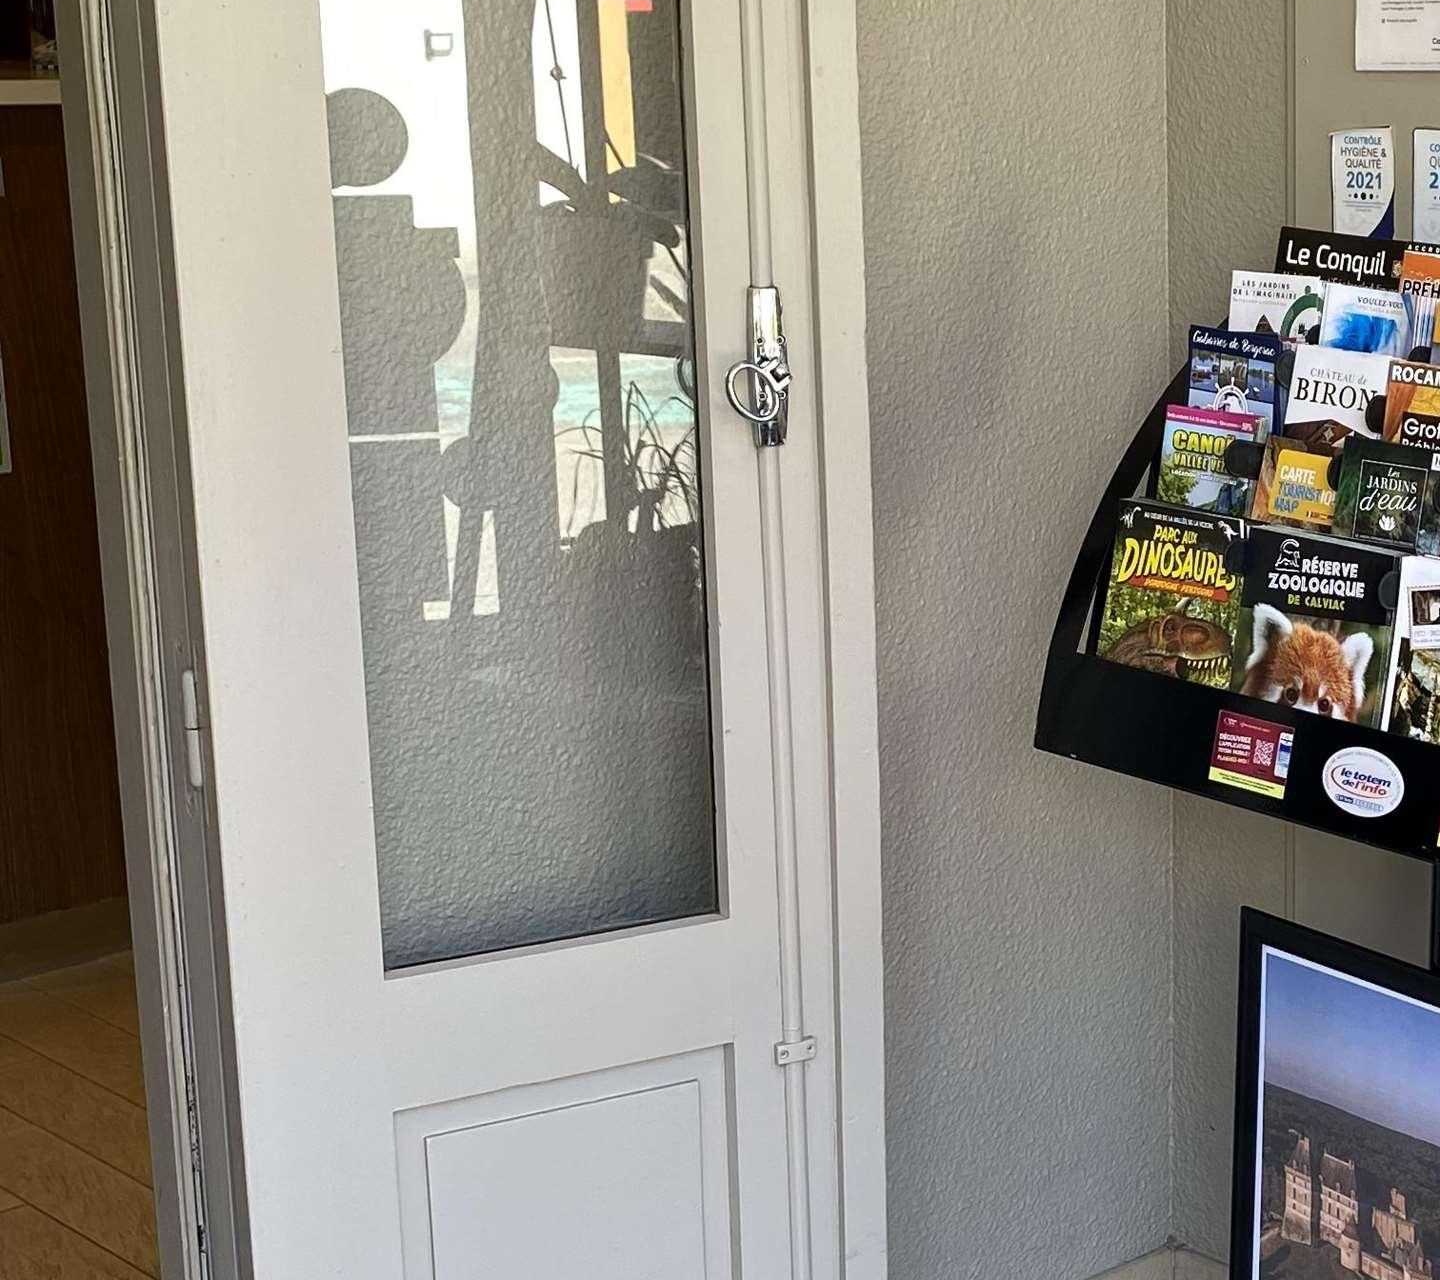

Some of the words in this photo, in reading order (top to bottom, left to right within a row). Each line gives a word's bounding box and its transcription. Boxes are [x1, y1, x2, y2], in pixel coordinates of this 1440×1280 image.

[1344, 136, 1382, 145] CONTRÔLE
[1381, 148, 1387, 157] &
[1345, 157, 1382, 169] QUALITÉ
[1346, 171, 1382, 189] 2021
[1286, 240, 1310, 266] Le
[1316, 244, 1386, 281] Conquil
[1233, 288, 1243, 296] DE
[1245, 288, 1297, 300] L'IMAGINAIRE
[1242, 279, 1256, 288] LES
[1259, 280, 1290, 290] JARDINS
[1228, 337, 1240, 350] de
[1241, 338, 1277, 358] Bergerac
[1357, 375, 1369, 386] de
[1294, 377, 1379, 412] BIRON
[1172, 428, 1235, 458] CANO
[1280, 464, 1317, 485] CARTE
[1387, 466, 1401, 478] Les
[1366, 475, 1418, 495] JARDINS
[1359, 489, 1418, 512] d'eau
[1153, 524, 1181, 543] PARC
[1182, 530, 1199, 545] AUX
[1301, 555, 1359, 579] RÉSERVE
[1267, 572, 1366, 599] ZOOLOGIQUE
[1287, 593, 1300, 606] DE
[1304, 596, 1345, 611] CALVIAC
[1340, 767, 1352, 778] le
[1353, 771, 1391, 787] totem
[1341, 779, 1354, 788] de
[1354, 781, 1387, 796] l'info
